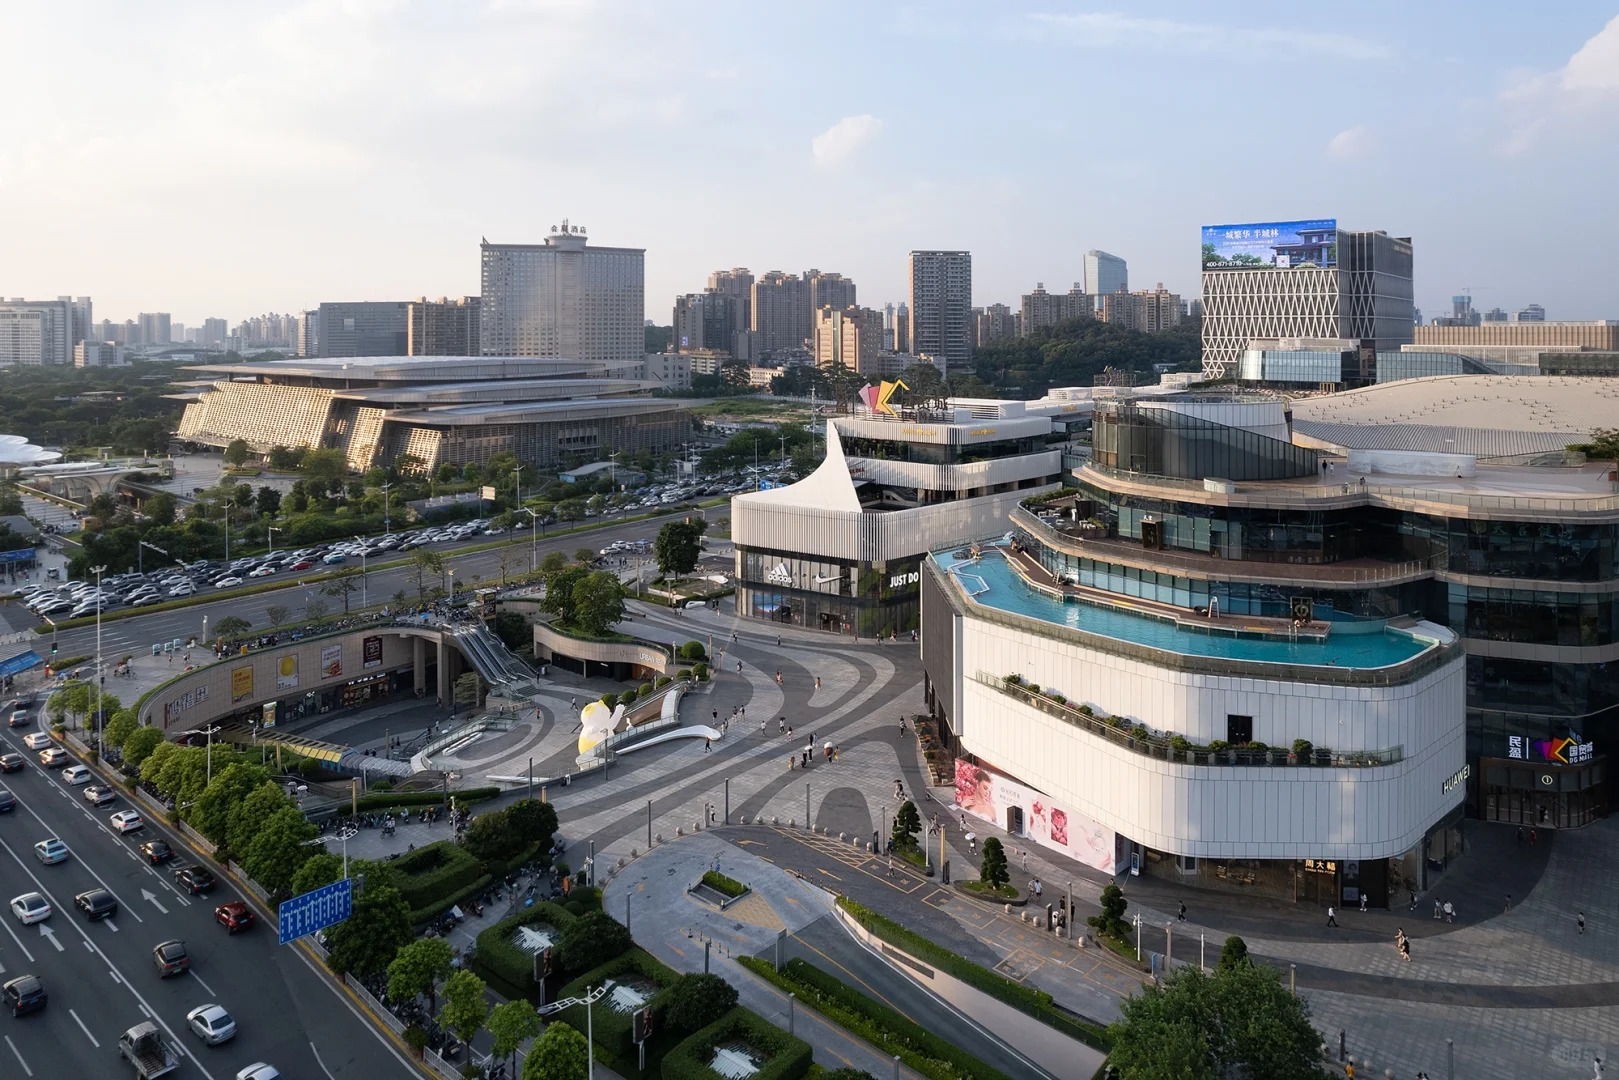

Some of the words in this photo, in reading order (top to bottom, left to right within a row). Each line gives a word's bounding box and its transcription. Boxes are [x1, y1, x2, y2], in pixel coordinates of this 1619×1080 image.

[768, 574, 792, 584] adidas
[890, 573, 907, 588] JUST
[908, 571, 919, 584] DO
[1509, 735, 1522, 759] 民盈
[1569, 741, 1593, 757] 国贸城
[1579, 753, 1593, 762] MALL
[1443, 764, 1470, 795] HUAWEI
